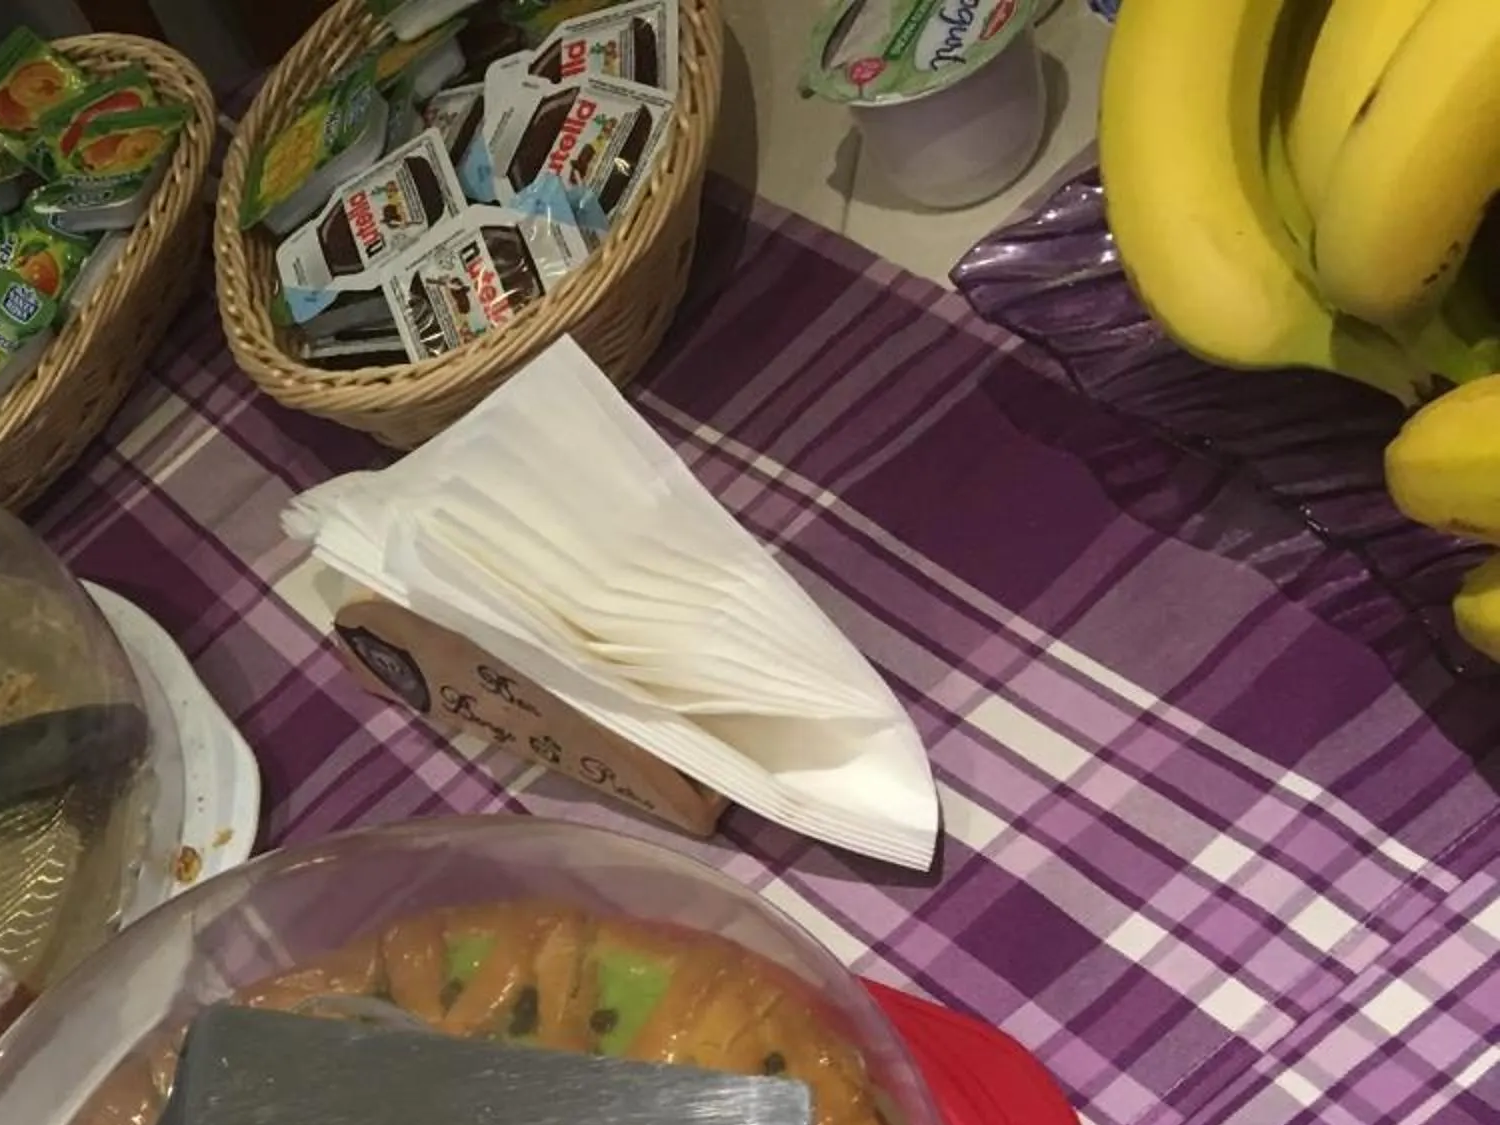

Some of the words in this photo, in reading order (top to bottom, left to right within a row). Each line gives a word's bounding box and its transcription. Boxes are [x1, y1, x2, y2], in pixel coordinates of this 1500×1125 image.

[930, 0, 980, 71] ogurt
[547, 99, 597, 177] tella
[461, 242, 514, 323] nutell
